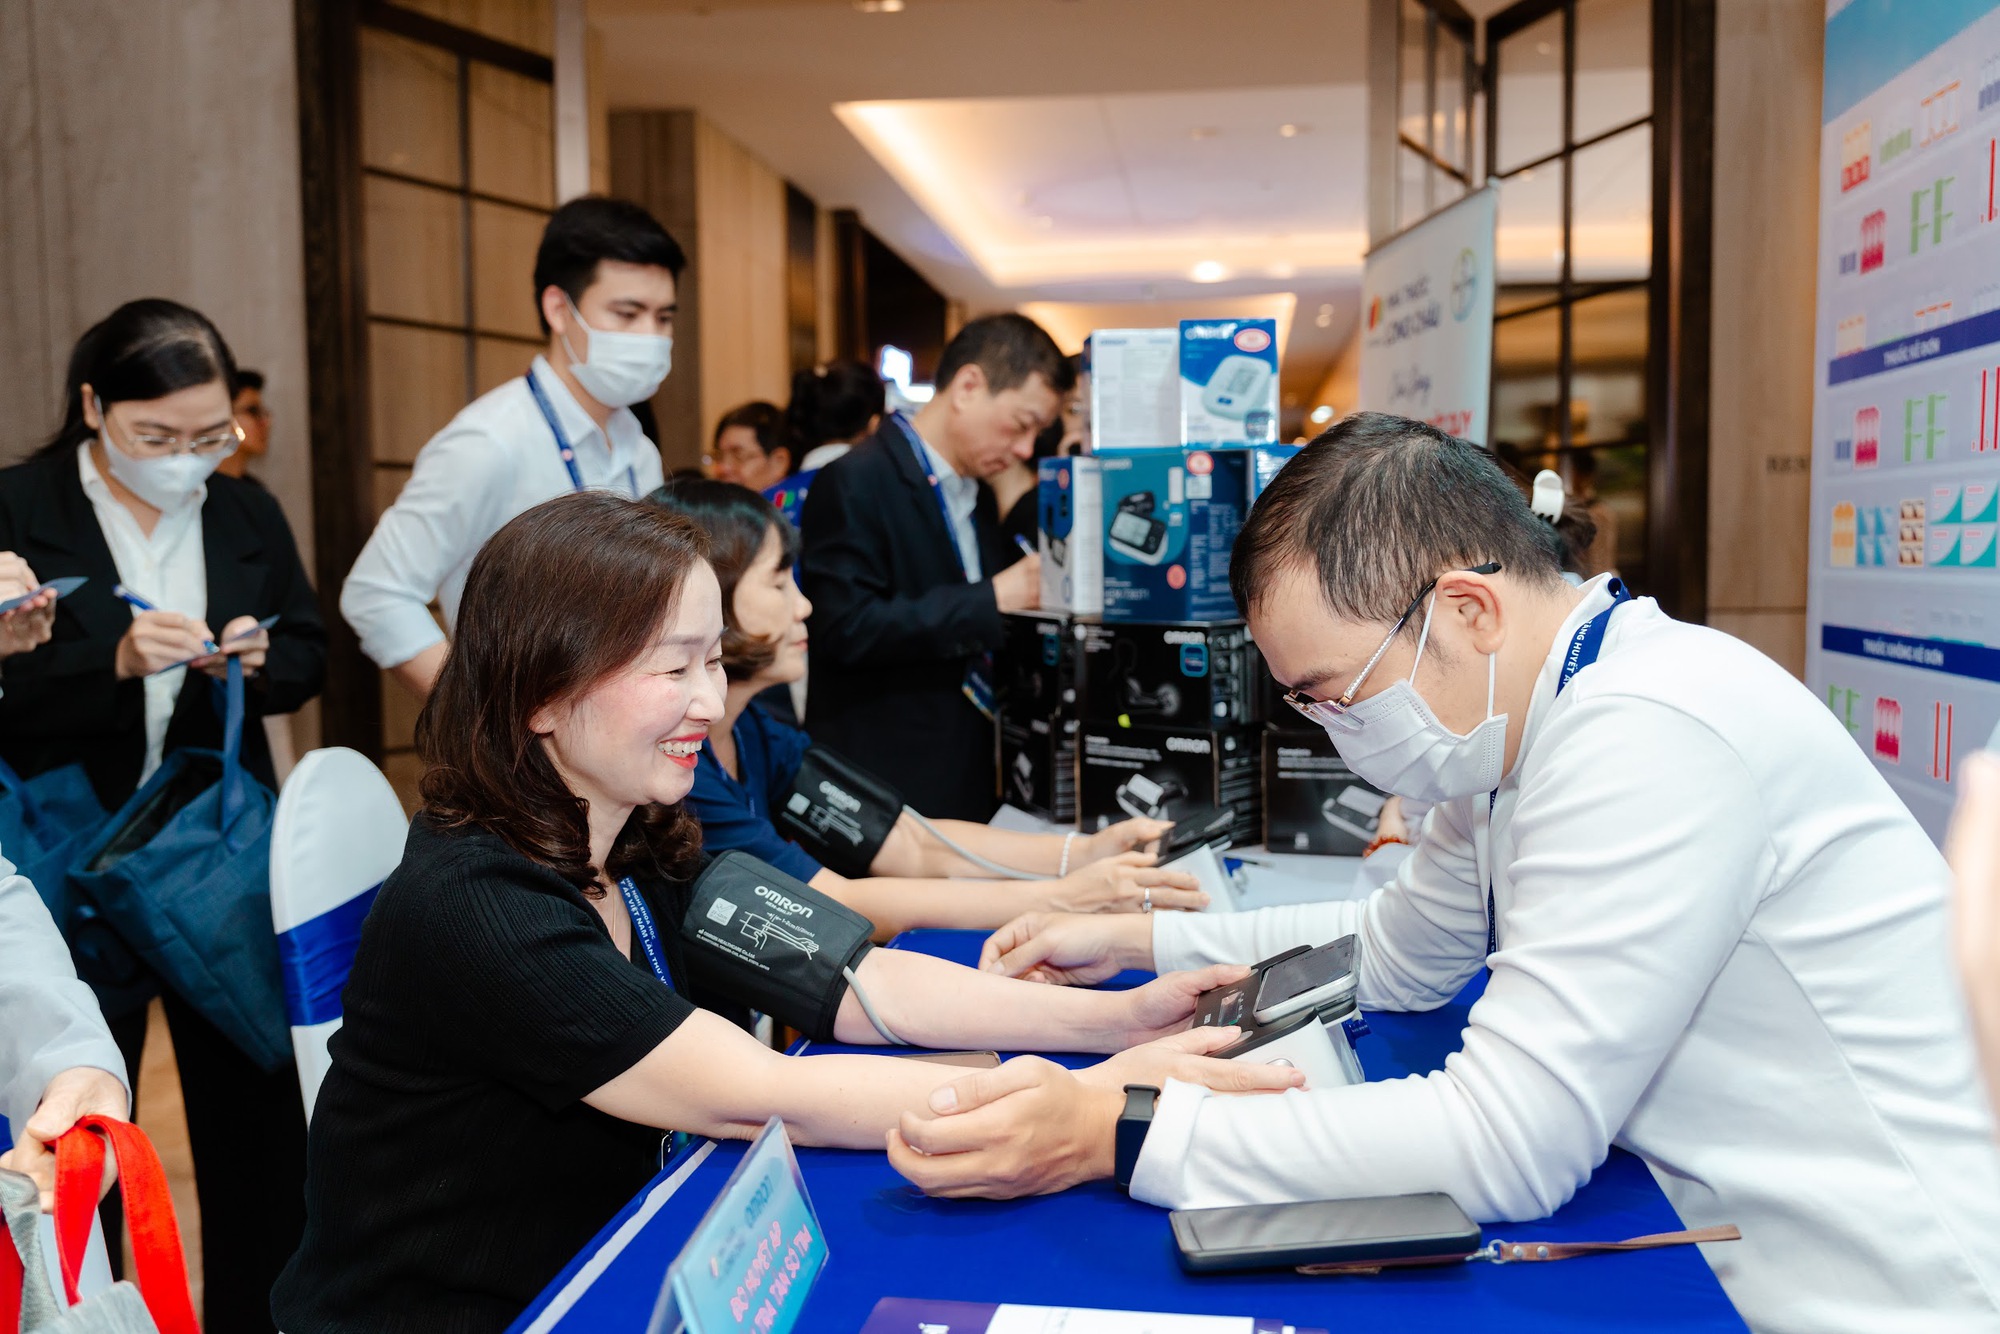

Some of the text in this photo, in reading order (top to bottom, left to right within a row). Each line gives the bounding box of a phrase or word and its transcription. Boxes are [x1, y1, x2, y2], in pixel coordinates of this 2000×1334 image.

[1567, 642, 1582, 674] HUYẾT
[625, 877, 656, 940] HỘI NGHỊ KHOA HỌC
[754, 885, 813, 919] OMRON
[623, 887, 631, 898] ÁP
[628, 899, 640, 916] VIỆT
[636, 918, 648, 938] NAM
[644, 940, 655, 956] LẦN
[652, 956, 663, 974] THỨ
[718, 938, 742, 952] HEALTHCARE
